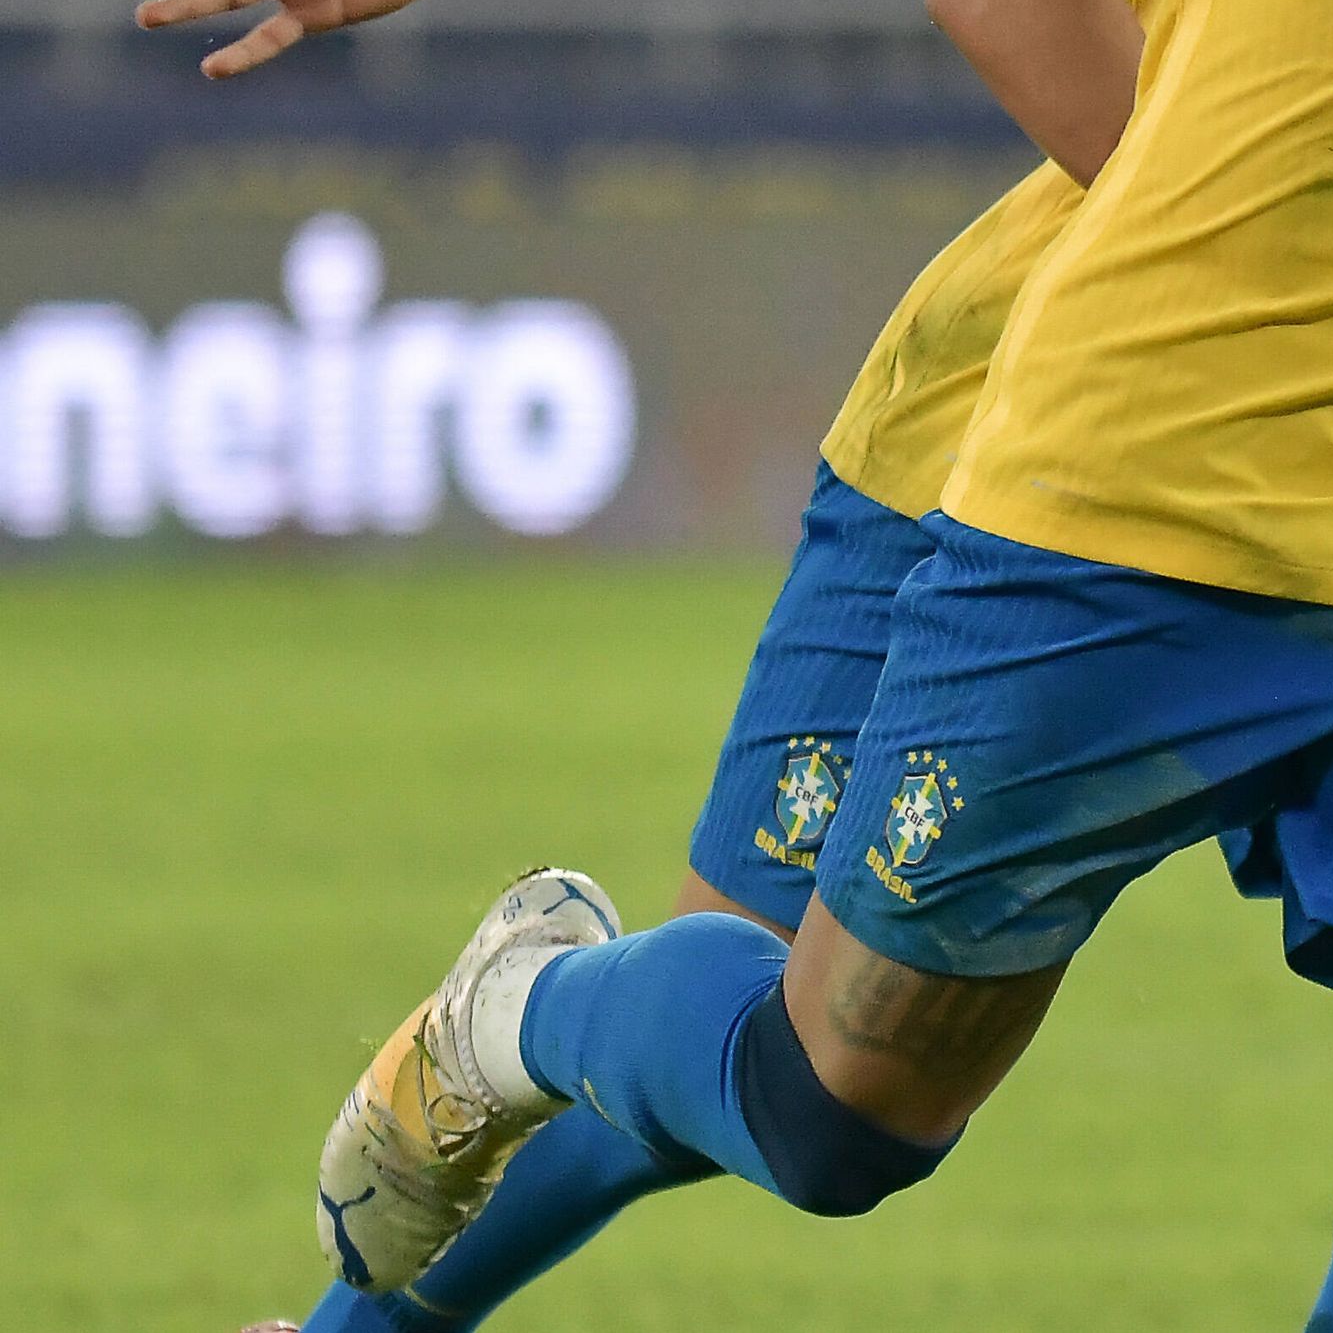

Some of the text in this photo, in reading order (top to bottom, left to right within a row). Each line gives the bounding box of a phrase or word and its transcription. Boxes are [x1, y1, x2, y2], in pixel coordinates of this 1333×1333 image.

[795, 786, 818, 807] CBF
[904, 806, 926, 829] CBF
[754, 827, 816, 871] BRASIL
[866, 846, 918, 904] BRASIL
